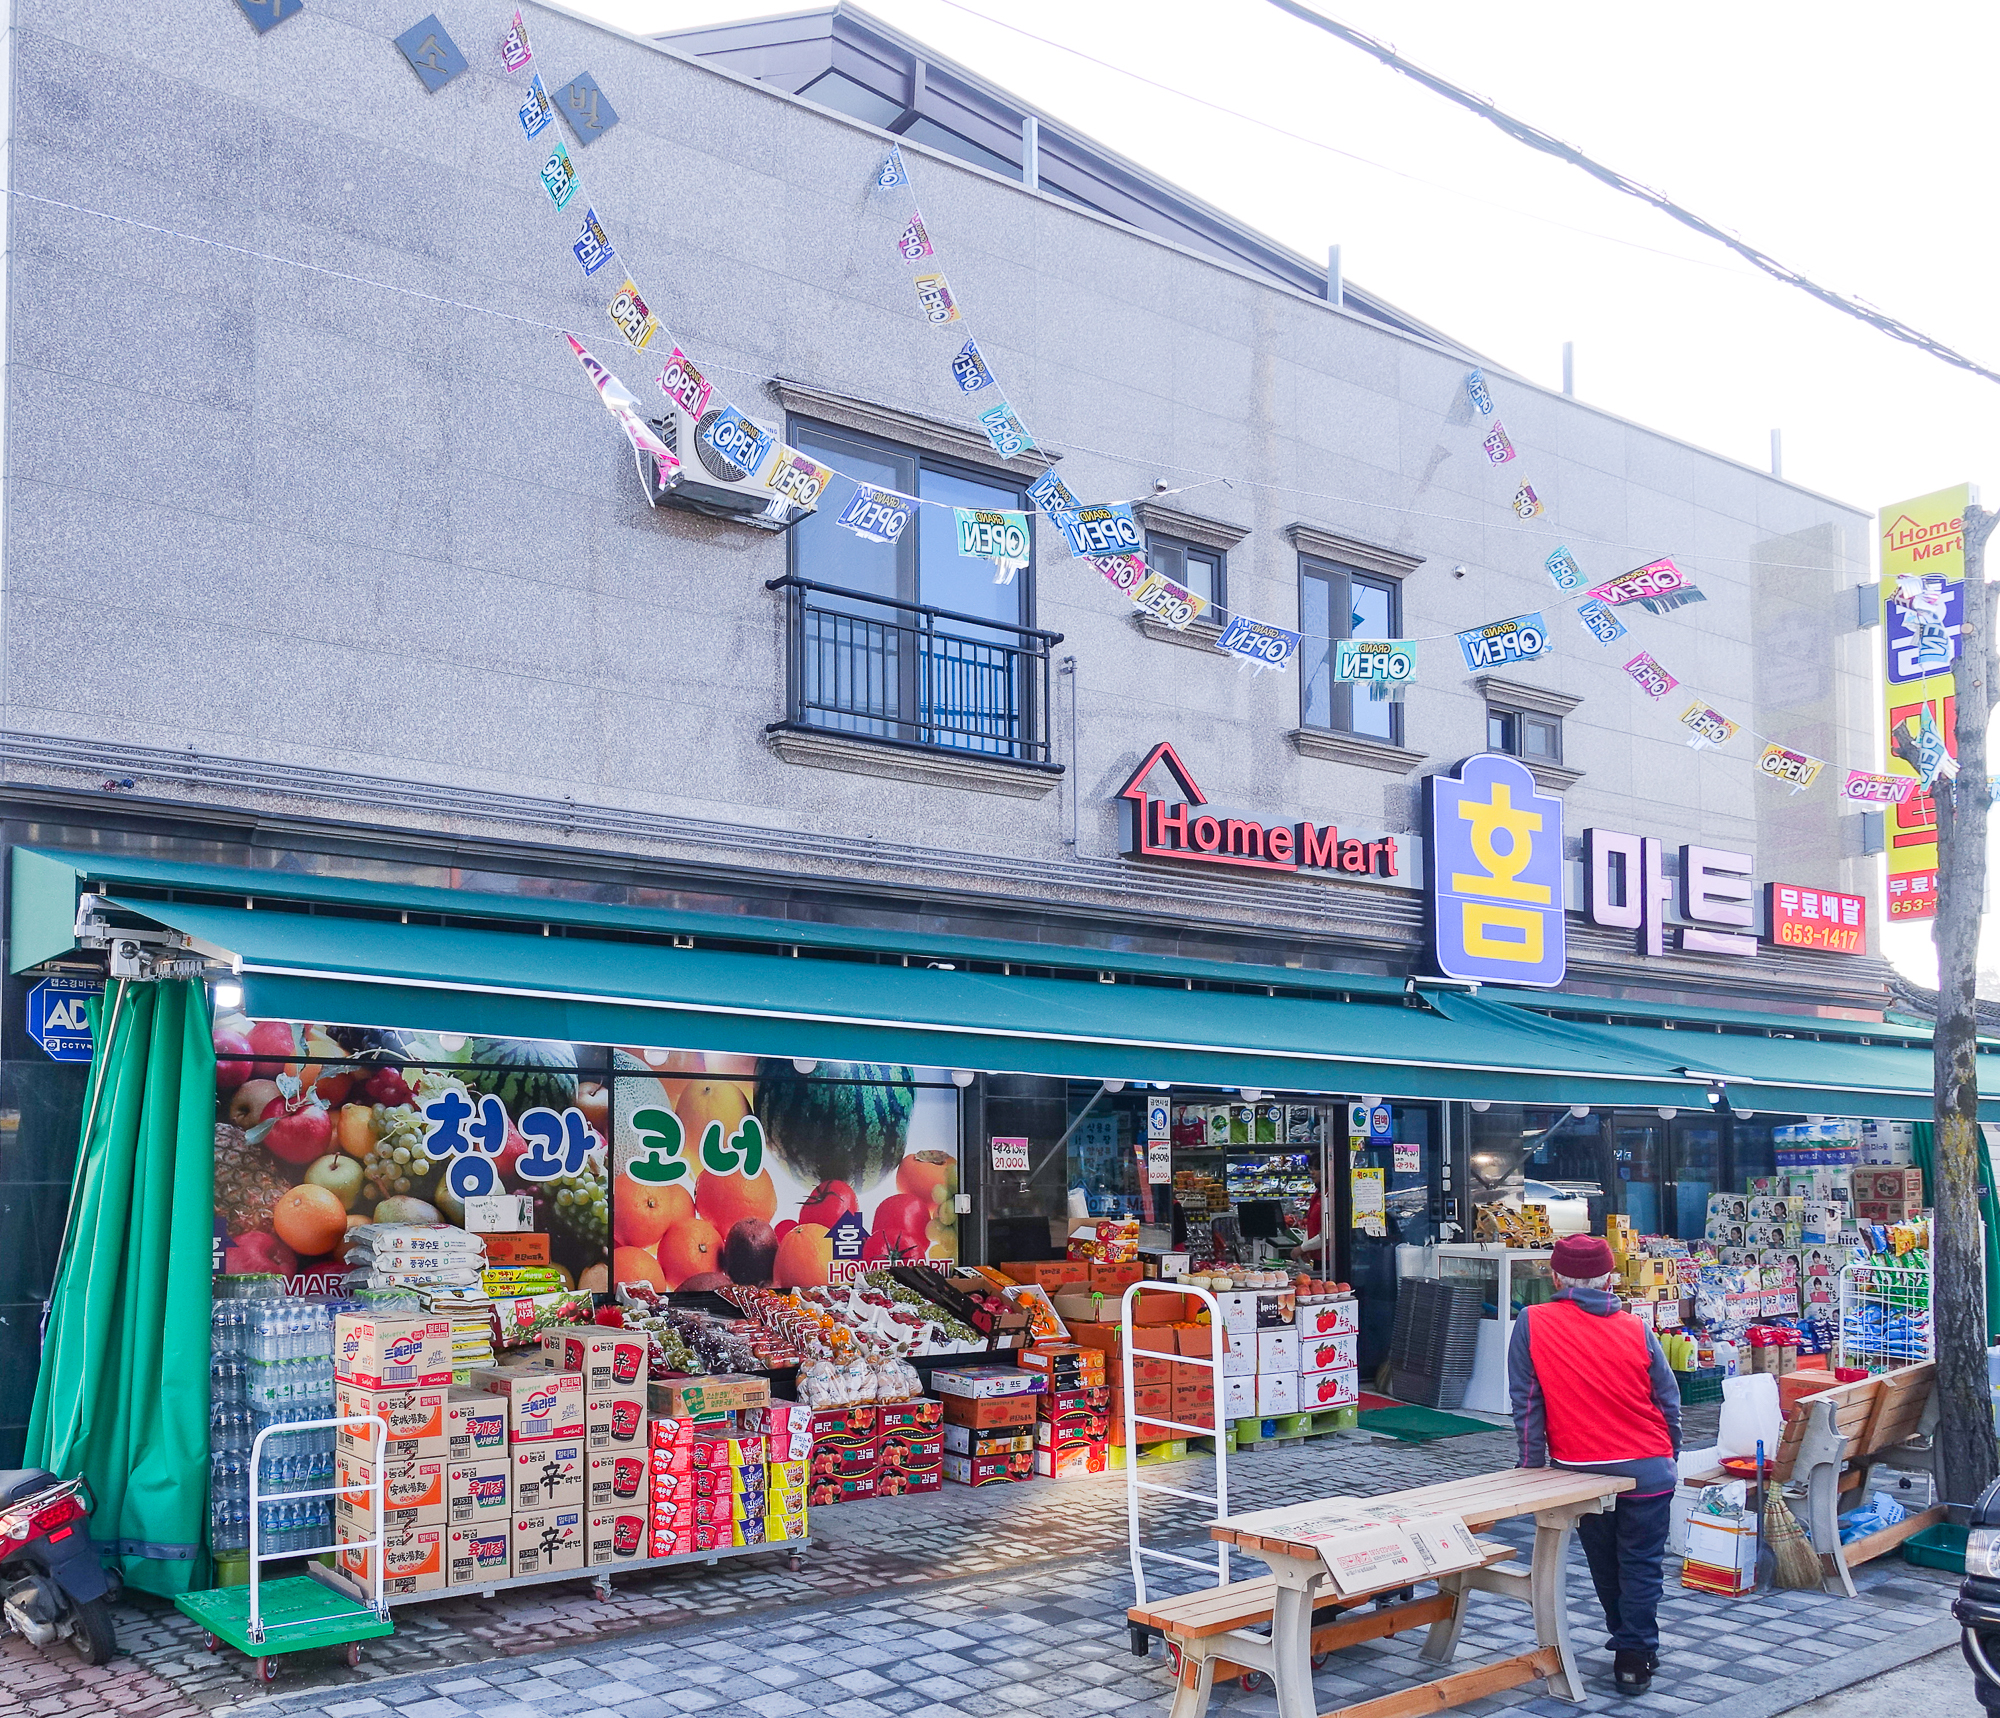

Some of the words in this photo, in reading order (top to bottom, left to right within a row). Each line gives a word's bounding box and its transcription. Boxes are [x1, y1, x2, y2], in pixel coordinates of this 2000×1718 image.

[541, 154, 572, 207] OPEN
[610, 293, 651, 348] OPEN
[661, 363, 707, 416] OPEN
[738, 418, 760, 440] GRAND
[712, 420, 763, 471] OPEN
[1899, 516, 1963, 546] Home
[1912, 536, 1963, 562] Mart
[1760, 752, 1815, 785] OPEN
[1869, 774, 1898, 784] GRAND
[1847, 780, 1907, 802] OPEN
[1153, 799, 1294, 862] Home
[1301, 821, 1399, 877] Mart
[1451, 781, 1552, 964] 홈
[1590, 827, 1758, 957] 마트
[1780, 888, 1861, 926] 무료배달
[1781, 921, 1859, 950] 653-1417
[1374, 1114, 1389, 1126] 담배
[424, 1090, 597, 1199] 청과
[629, 1108, 763, 1182] 코너
[1803, 1211, 1819, 1223] ite
[410, 1240, 440, 1250] 풍광수토
[835, 1224, 862, 1256] 홈
[1838, 1235, 1860, 1246] hite
[409, 1258, 439, 1268] 풍광수토
[517, 1308, 534, 1319] 사과
[427, 1323, 449, 1332] 멀티팩
[614, 1351, 630, 1375] 辛
[560, 1377, 581, 1387] 멀티팩
[1009, 1379, 1021, 1389] 포도
[421, 1396, 441, 1406] 멀티팩
[598, 1400, 613, 1409] 농심
[459, 1409, 475, 1417] 농심
[613, 1407, 629, 1431] 辛
[465, 1420, 502, 1435] 육개장
[478, 1436, 500, 1447] 사발면
[556, 1449, 576, 1459] 멀티팩
[856, 1448, 874, 1461] 감귤
[923, 1442, 940, 1455] 감귤
[529, 1453, 546, 1463] 농심
[600, 1457, 615, 1466] 농심
[420, 1464, 440, 1475] 멀티팩
[461, 1470, 477, 1478] 농심
[540, 1460, 566, 1500] 辛
[565, 1475, 582, 1485] 라면
[615, 1465, 630, 1488] 辛
[921, 1472, 938, 1485] 감귤
[467, 1480, 504, 1496] 육개장
[856, 1478, 874, 1491] 감귤
[479, 1496, 503, 1508] 사발면
[528, 1519, 545, 1528] 농심
[557, 1514, 578, 1525] 멀티팩
[601, 1516, 615, 1525] 농심
[418, 1532, 439, 1542] 멀티팩
[462, 1531, 478, 1539] 농심
[615, 1523, 630, 1547] 辛
[467, 1541, 504, 1557] 육개장
[539, 1526, 566, 1565] 辛
[564, 1540, 582, 1550] 라면
[480, 1556, 503, 1567] 사발면
